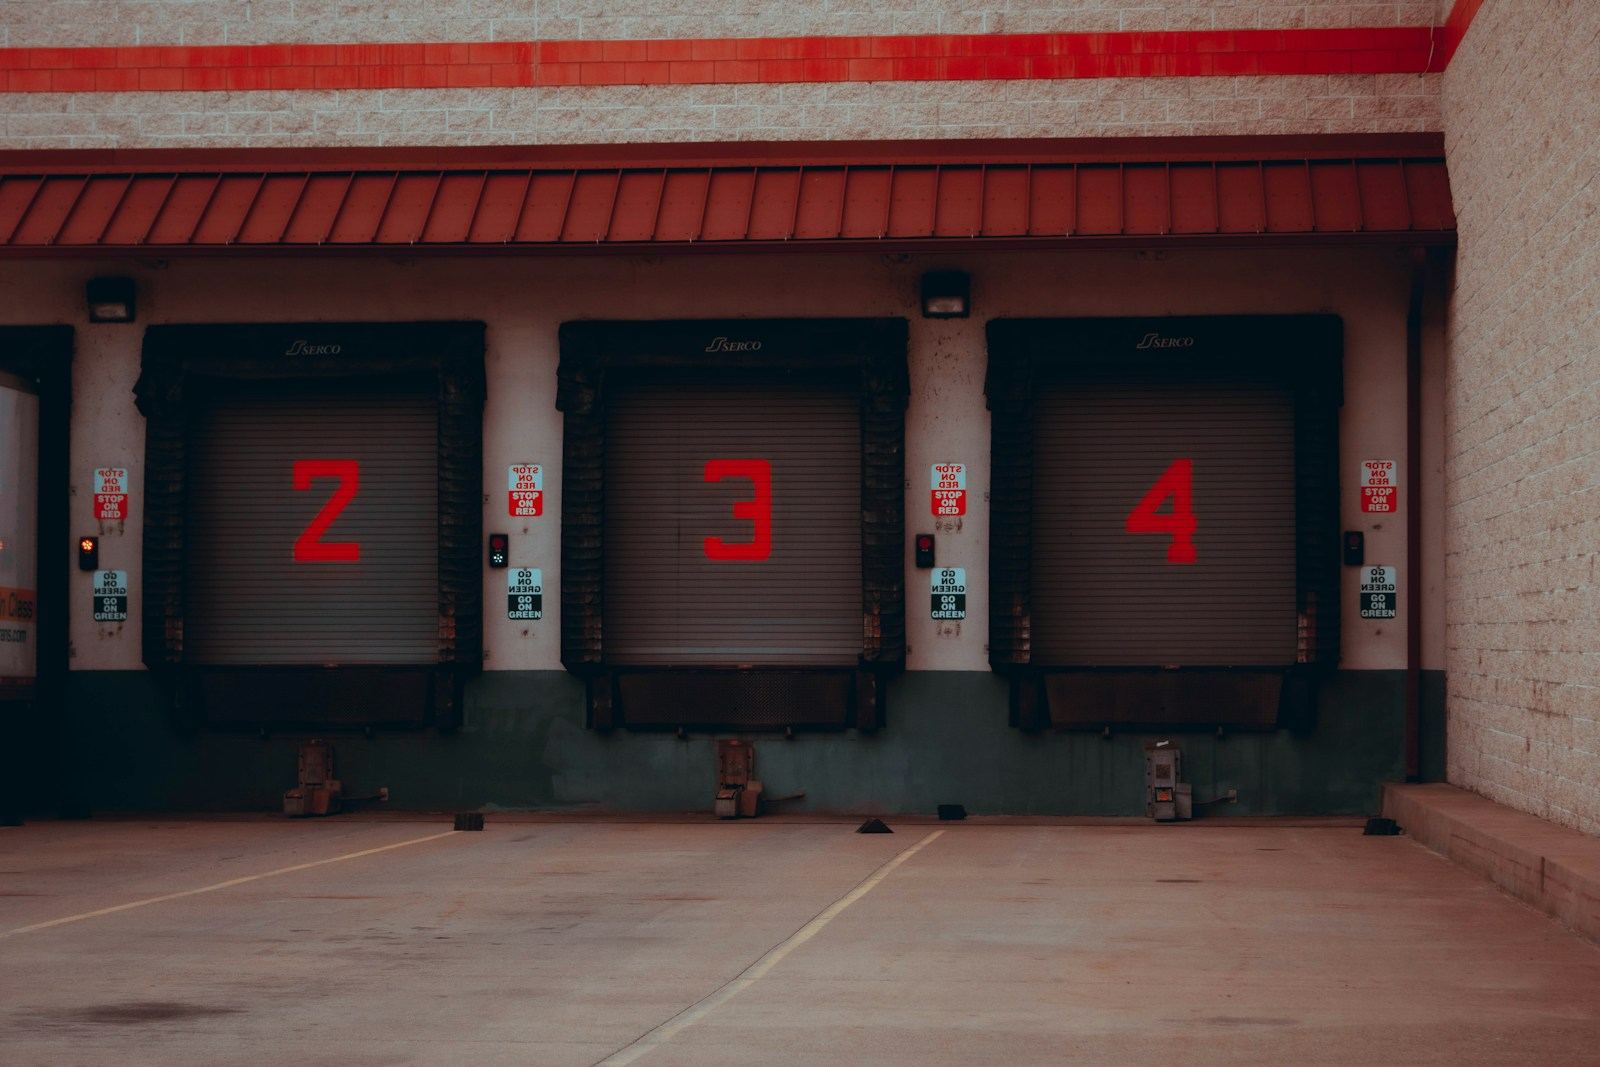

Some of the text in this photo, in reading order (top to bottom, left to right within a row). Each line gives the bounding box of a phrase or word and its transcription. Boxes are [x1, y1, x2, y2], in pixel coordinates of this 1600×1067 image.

[722, 341, 762, 351] SERCO
[1153, 337, 1194, 348] SERCO
[302, 343, 341, 355] SERCO
[512, 492, 539, 500] STOP
[935, 491, 962, 499] STOP
[1365, 488, 1392, 496] STOP
[98, 495, 124, 503] STOP
[941, 499, 956, 507] ON
[1371, 496, 1386, 504] ON
[104, 503, 118, 511] ON
[519, 500, 533, 508] ON
[1368, 503, 1389, 511] RED
[293, 459, 359, 561] 2
[703, 459, 771, 561] 3
[1125, 458, 1197, 563] 4
[518, 596, 532, 604] GO
[1371, 594, 1385, 602] GO
[9, 592, 33, 618] Class
[94, 612, 127, 620] GREEN
[1361, 609, 1395, 617] GREEN
